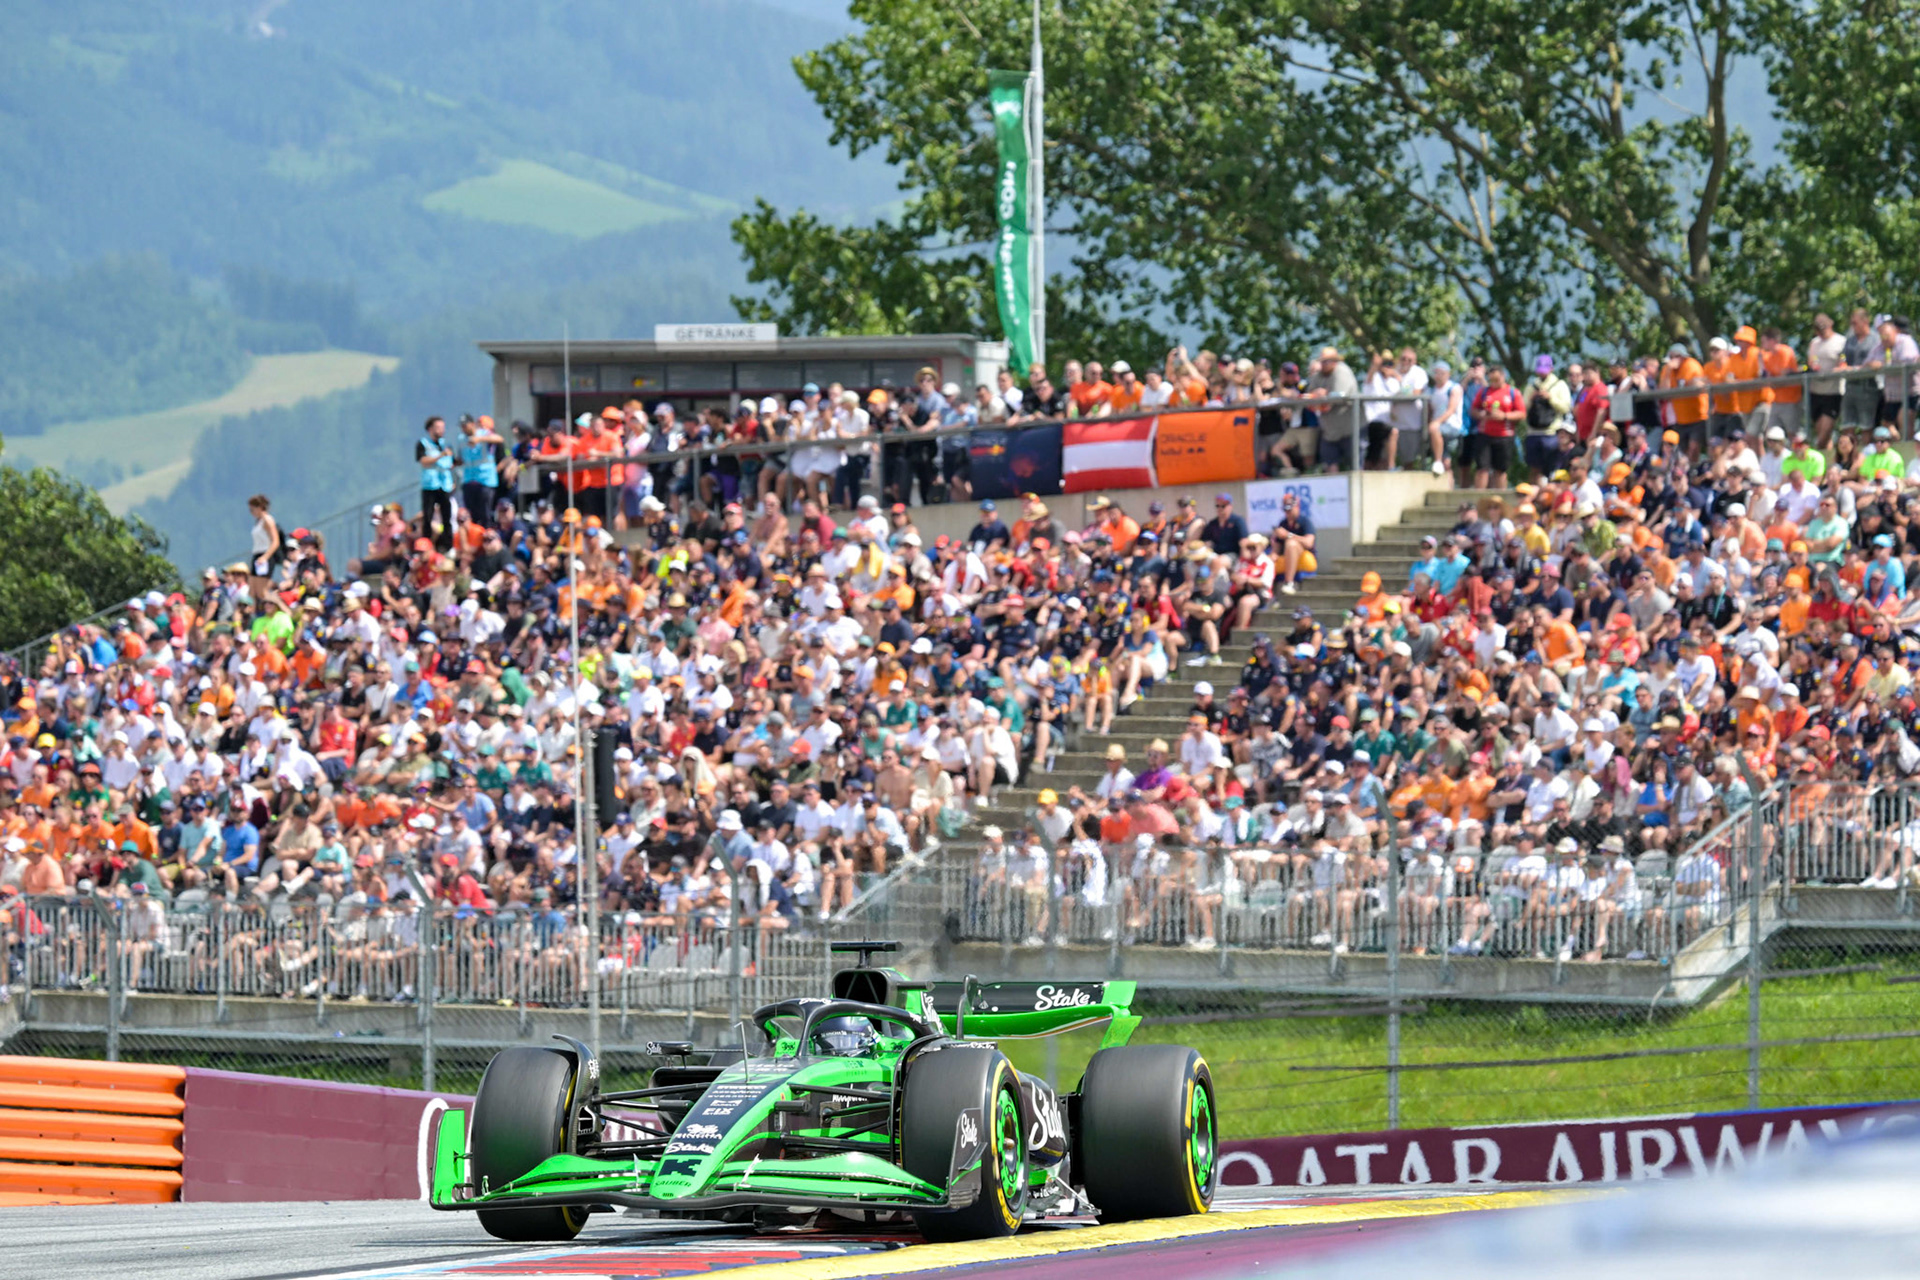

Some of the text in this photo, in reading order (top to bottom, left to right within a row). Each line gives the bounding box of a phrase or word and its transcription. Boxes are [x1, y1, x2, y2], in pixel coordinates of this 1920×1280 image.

[1251, 500, 1277, 510] VISA
[1034, 984, 1091, 1011] Stake
[960, 1112, 978, 1149] Stake
[665, 1142, 715, 1154] Stake
[1547, 1112, 1920, 1185] AIRWA
